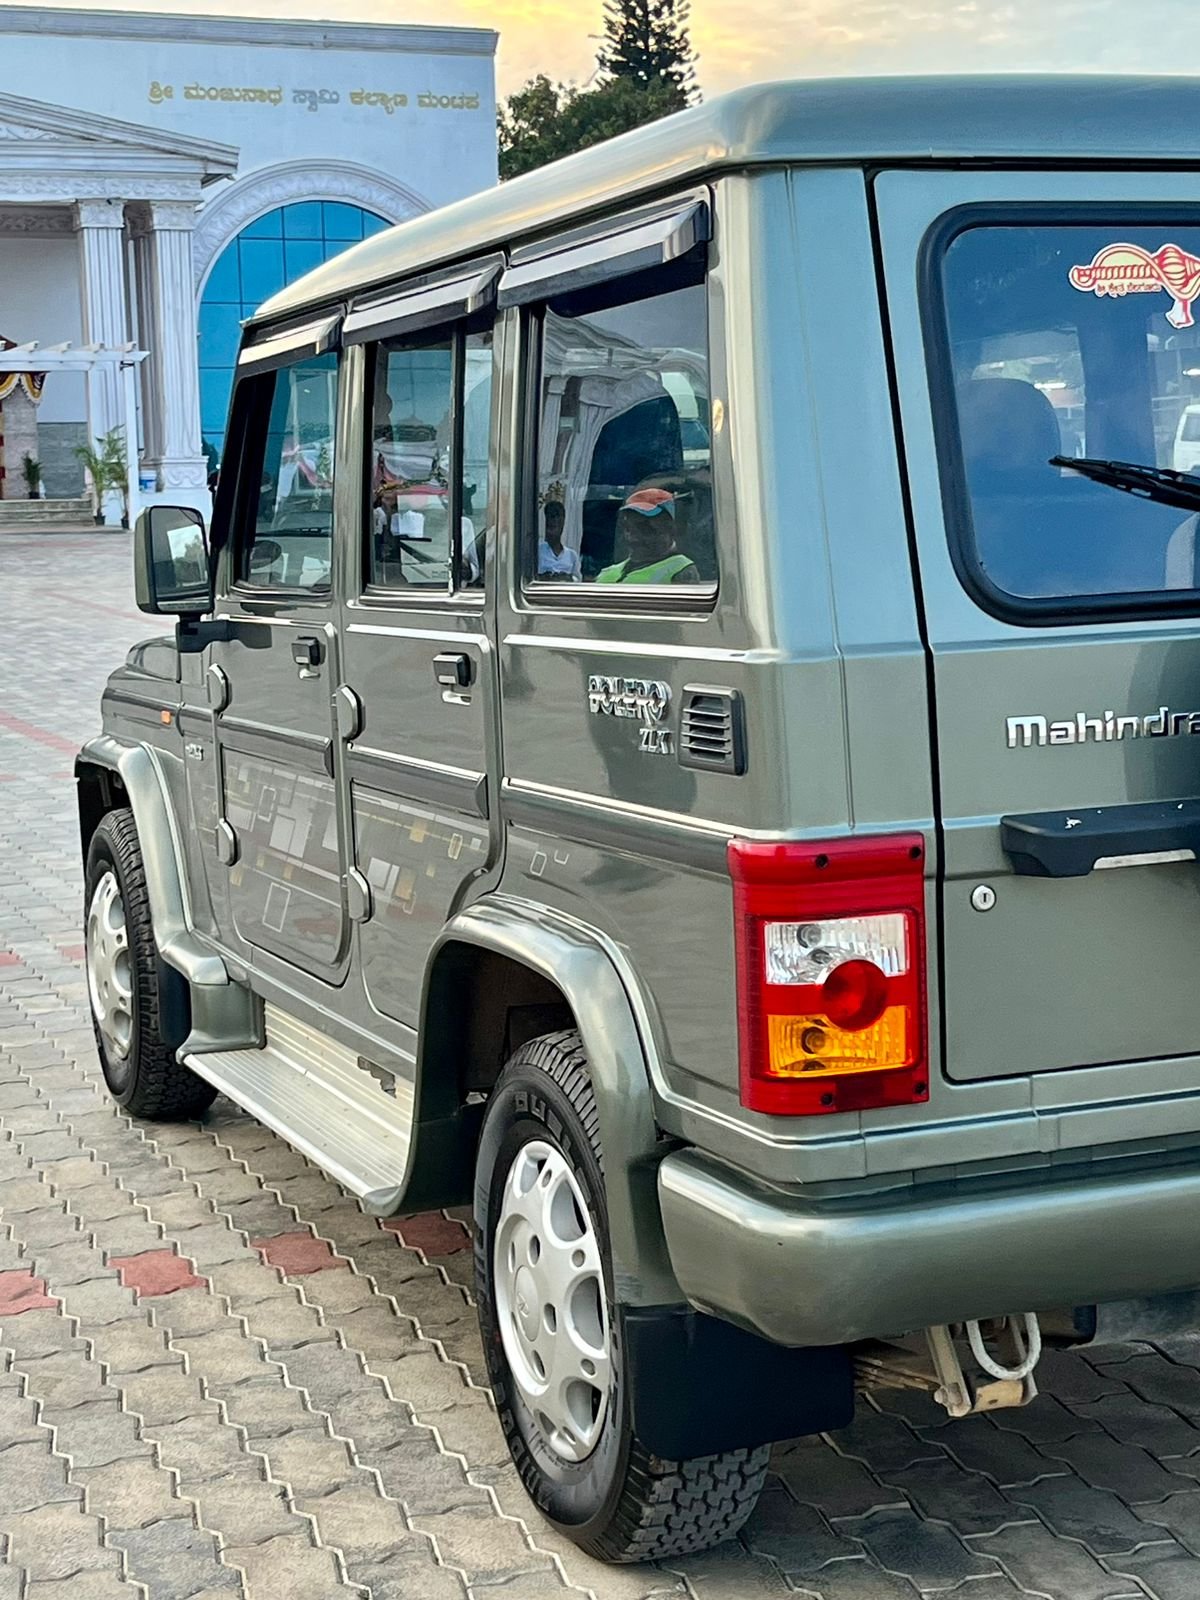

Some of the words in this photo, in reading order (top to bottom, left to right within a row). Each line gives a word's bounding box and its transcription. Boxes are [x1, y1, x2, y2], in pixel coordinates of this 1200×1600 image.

[149, 81, 173, 104] ಶ್ರೀ
[184, 83, 283, 106] ಮಂಜುನಾಥ
[350, 88, 408, 114] ಕಲ್ಯಾಣ
[417, 91, 480, 110] ಮಂಟಪ
